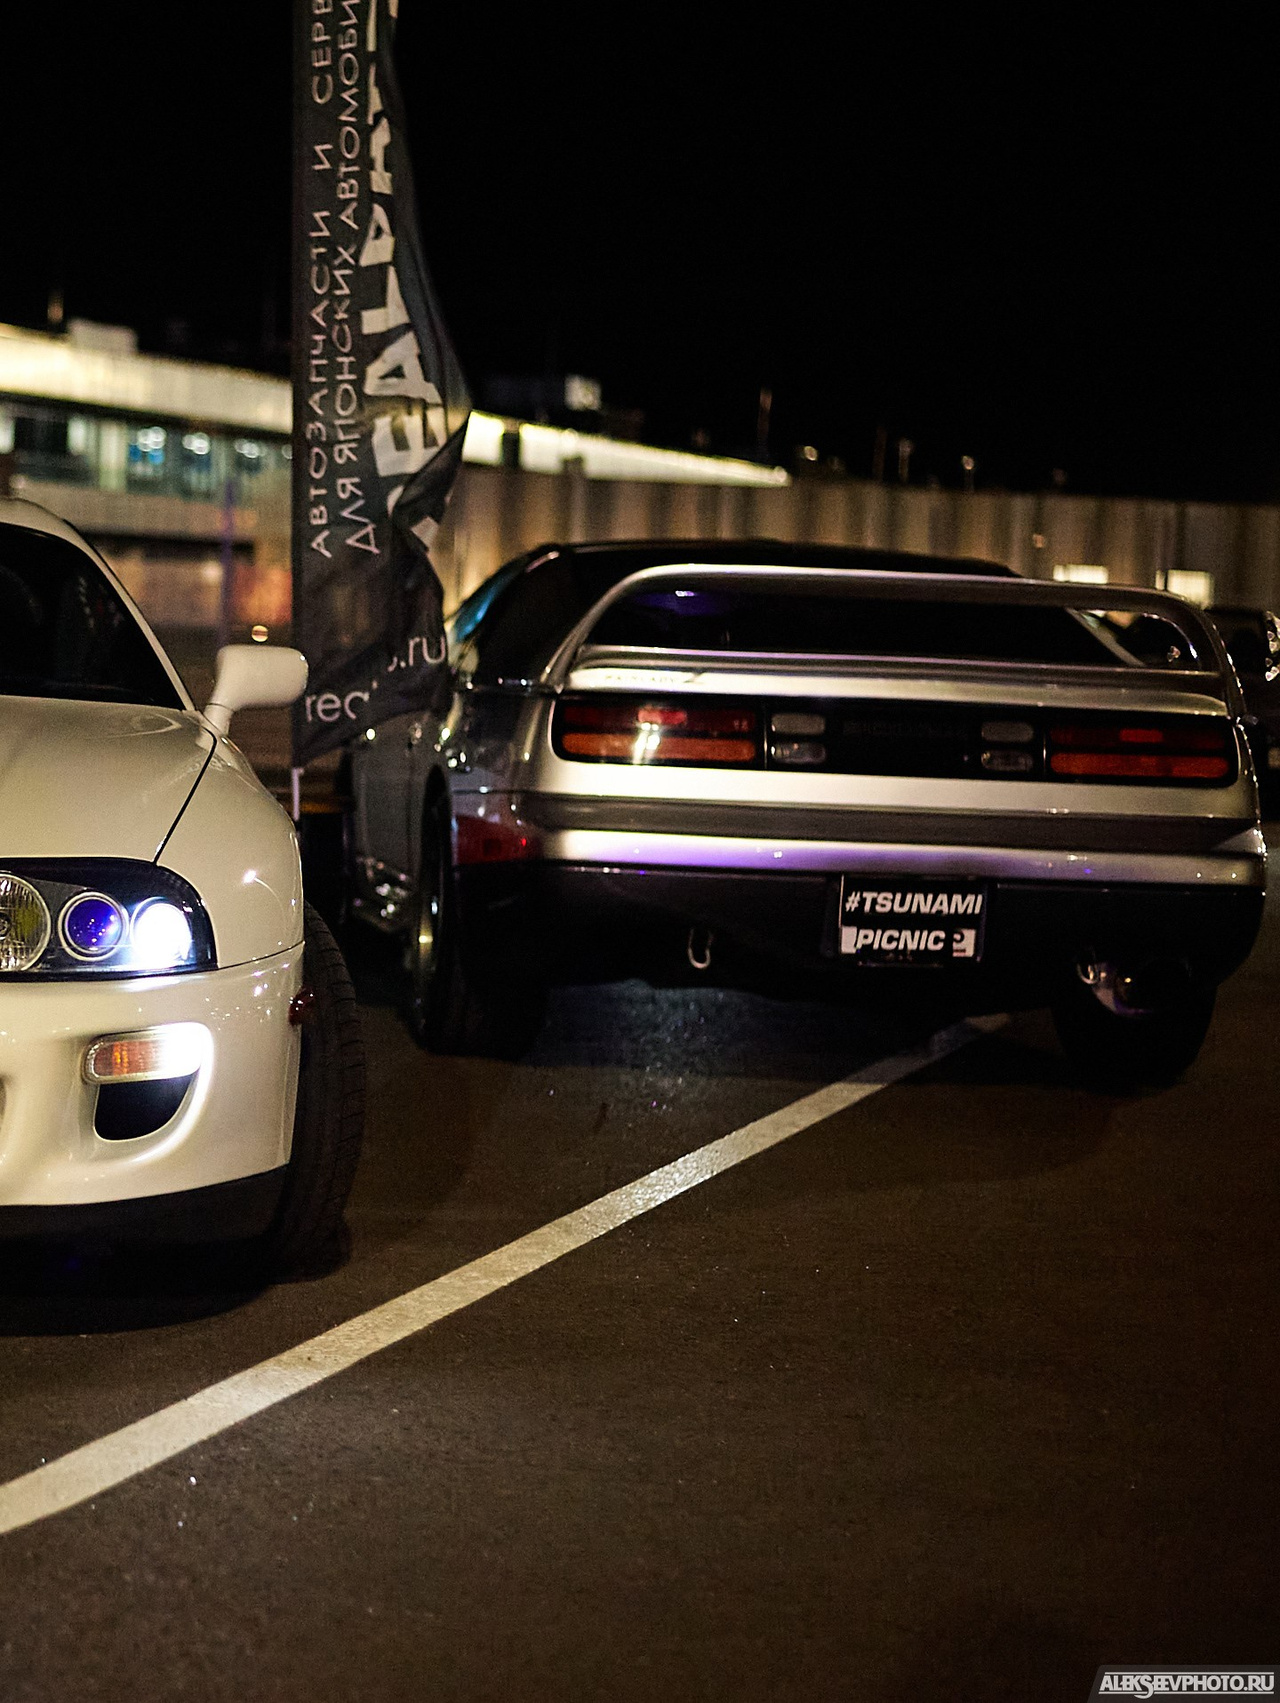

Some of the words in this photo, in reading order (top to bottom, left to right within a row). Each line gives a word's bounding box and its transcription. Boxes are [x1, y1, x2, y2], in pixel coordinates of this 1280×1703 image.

[313, 143, 334, 171] И
[331, 244, 362, 462] ЯПОНСКИХ
[306, 210, 333, 559] АВТОЗАПЧАСТИ
[337, 475, 381, 555] ДЛЯ
[845, 890, 983, 915] #TSUNAMI
[856, 928, 946, 951] PICNIC
